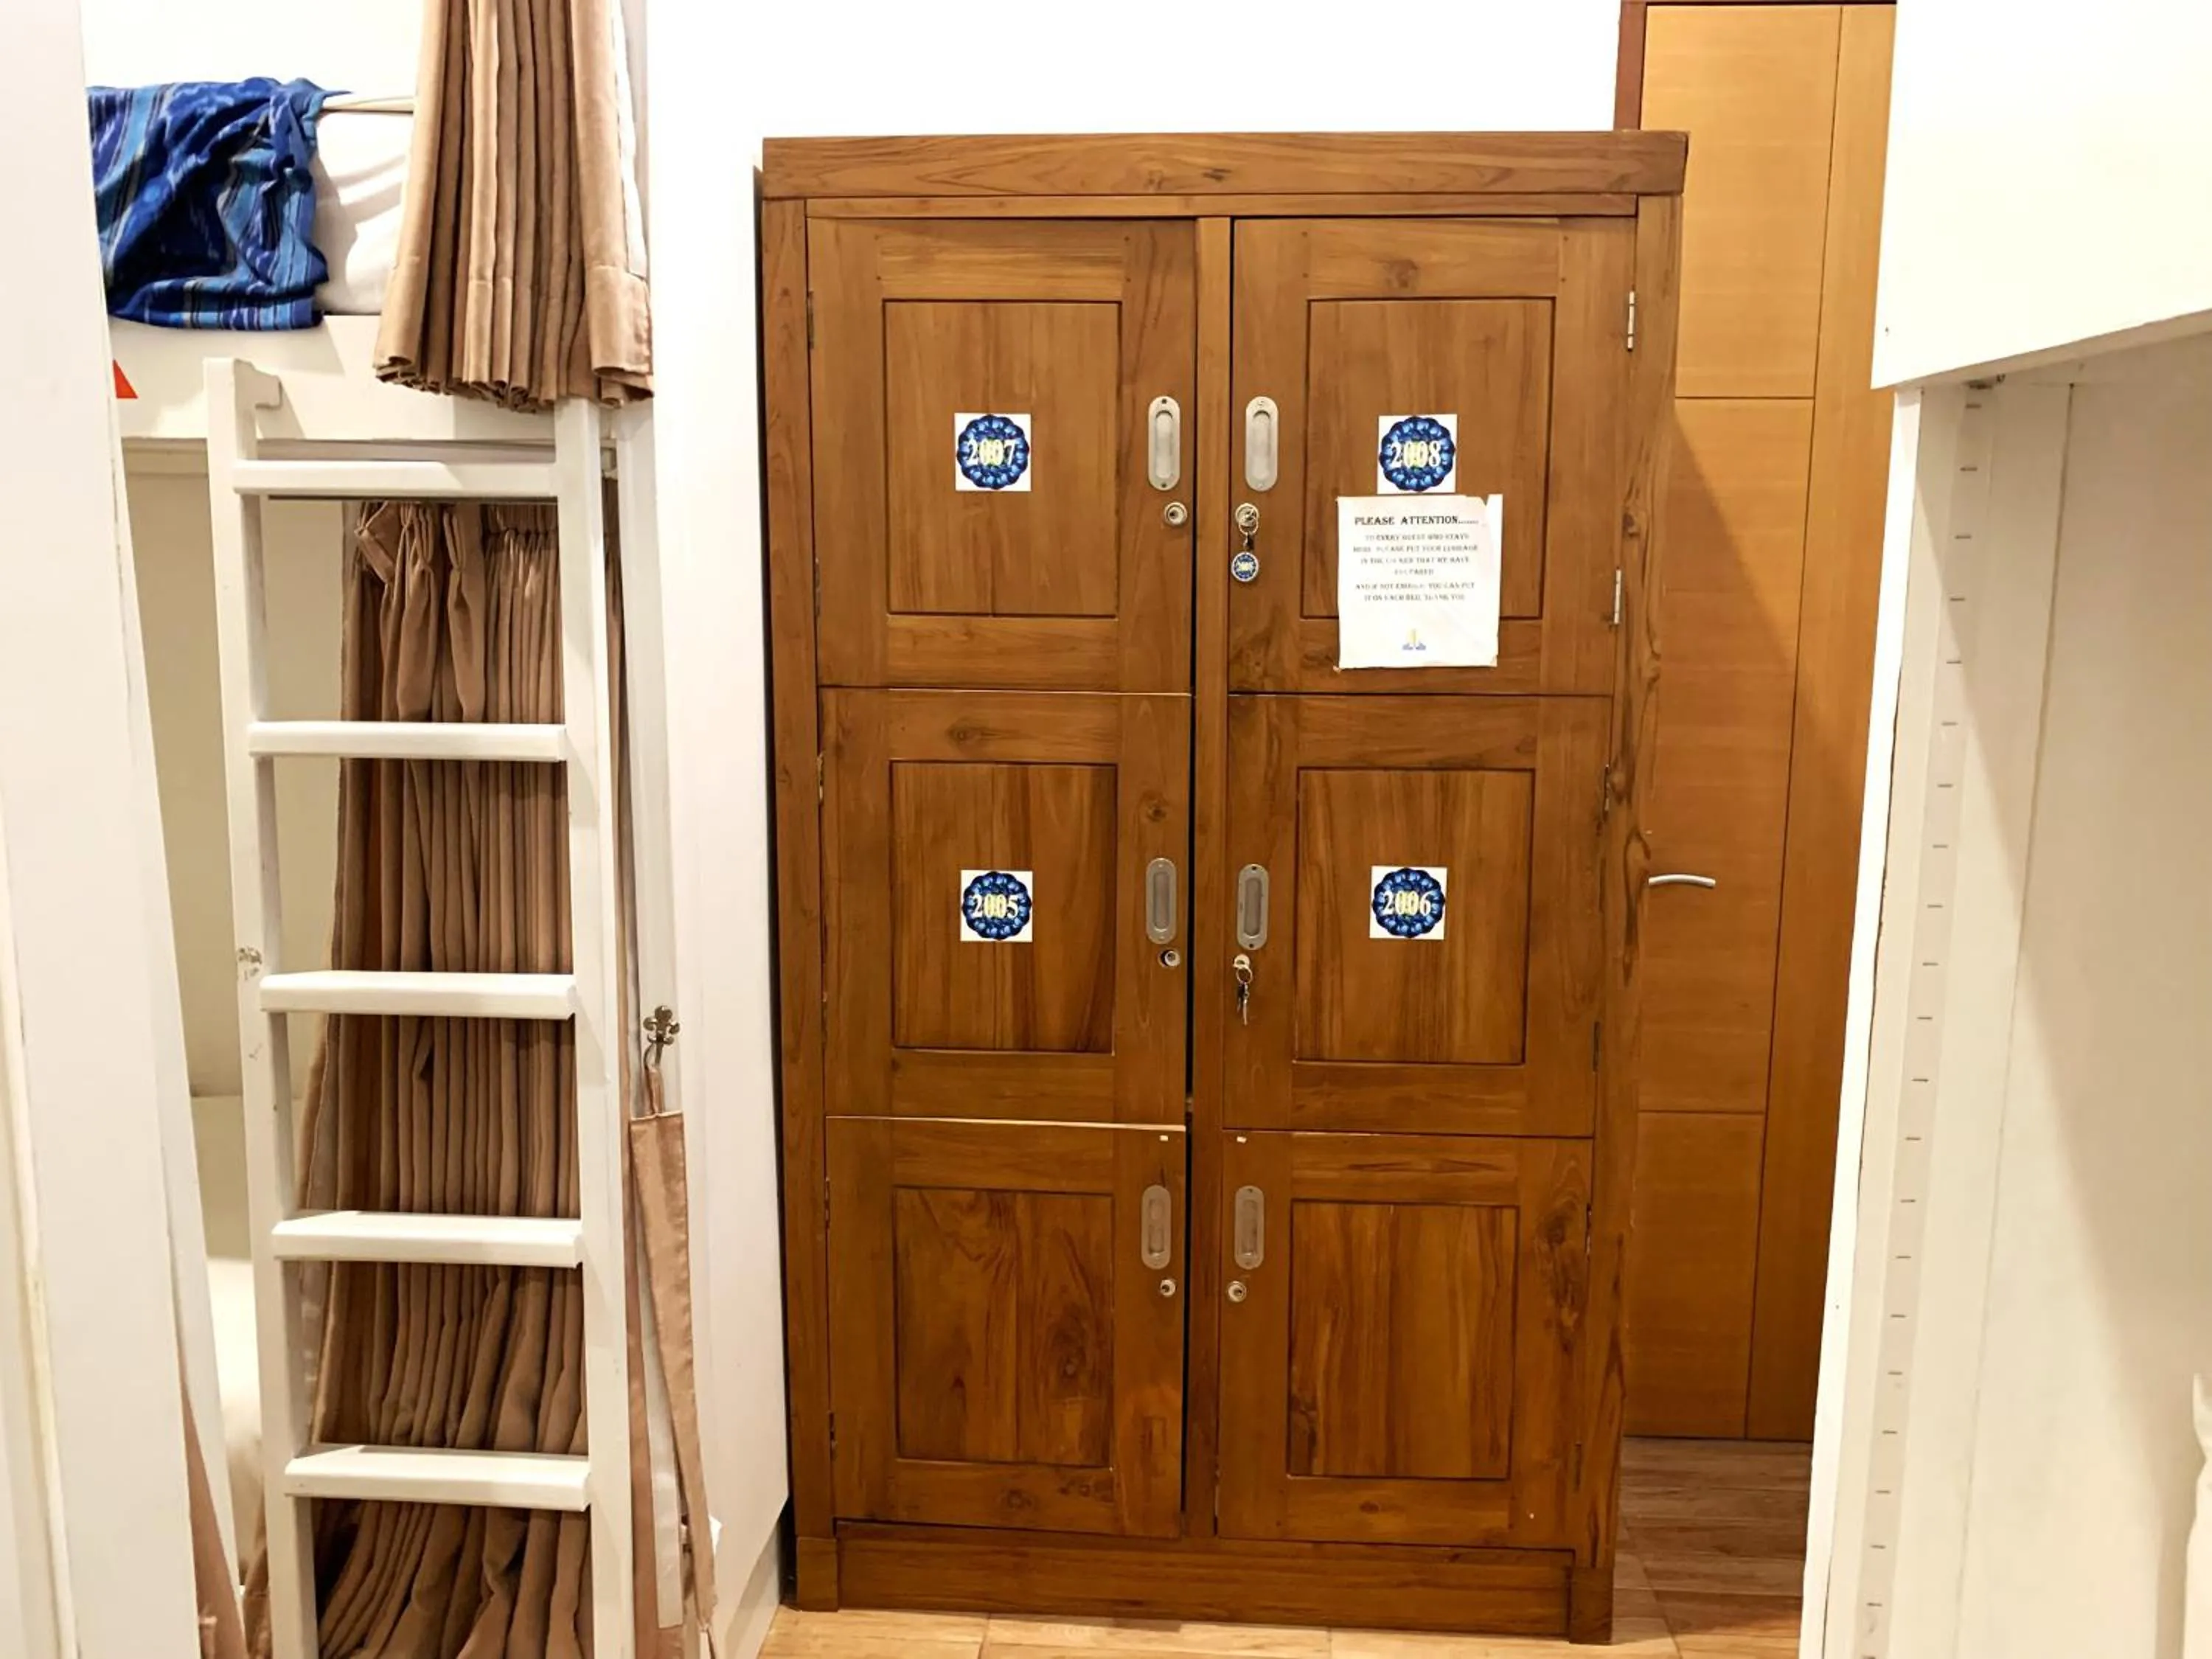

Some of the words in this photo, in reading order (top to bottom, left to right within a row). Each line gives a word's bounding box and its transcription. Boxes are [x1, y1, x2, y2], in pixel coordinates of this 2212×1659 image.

[967, 438, 1015, 467] 2007
[1387, 440, 1441, 470] 2008
[1354, 517, 1395, 526] PLEASE
[970, 893, 1019, 919] 2005
[1382, 890, 1433, 916] 2006
